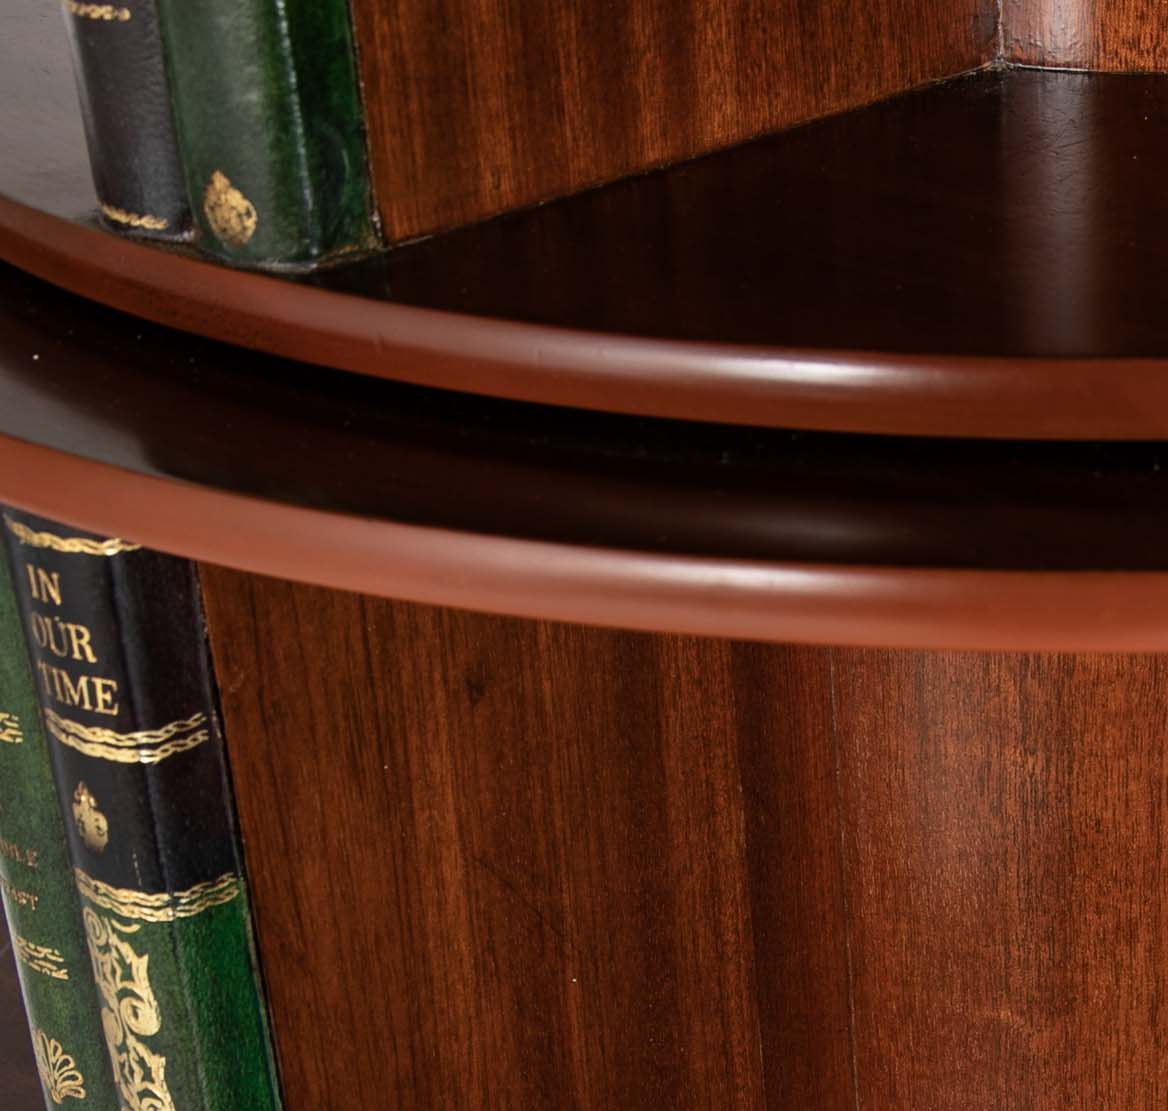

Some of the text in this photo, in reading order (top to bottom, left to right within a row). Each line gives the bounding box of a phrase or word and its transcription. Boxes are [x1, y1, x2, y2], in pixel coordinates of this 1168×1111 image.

[26, 563, 62, 606] IN
[31, 612, 98, 664] OUR
[37, 659, 120, 717] TIME
